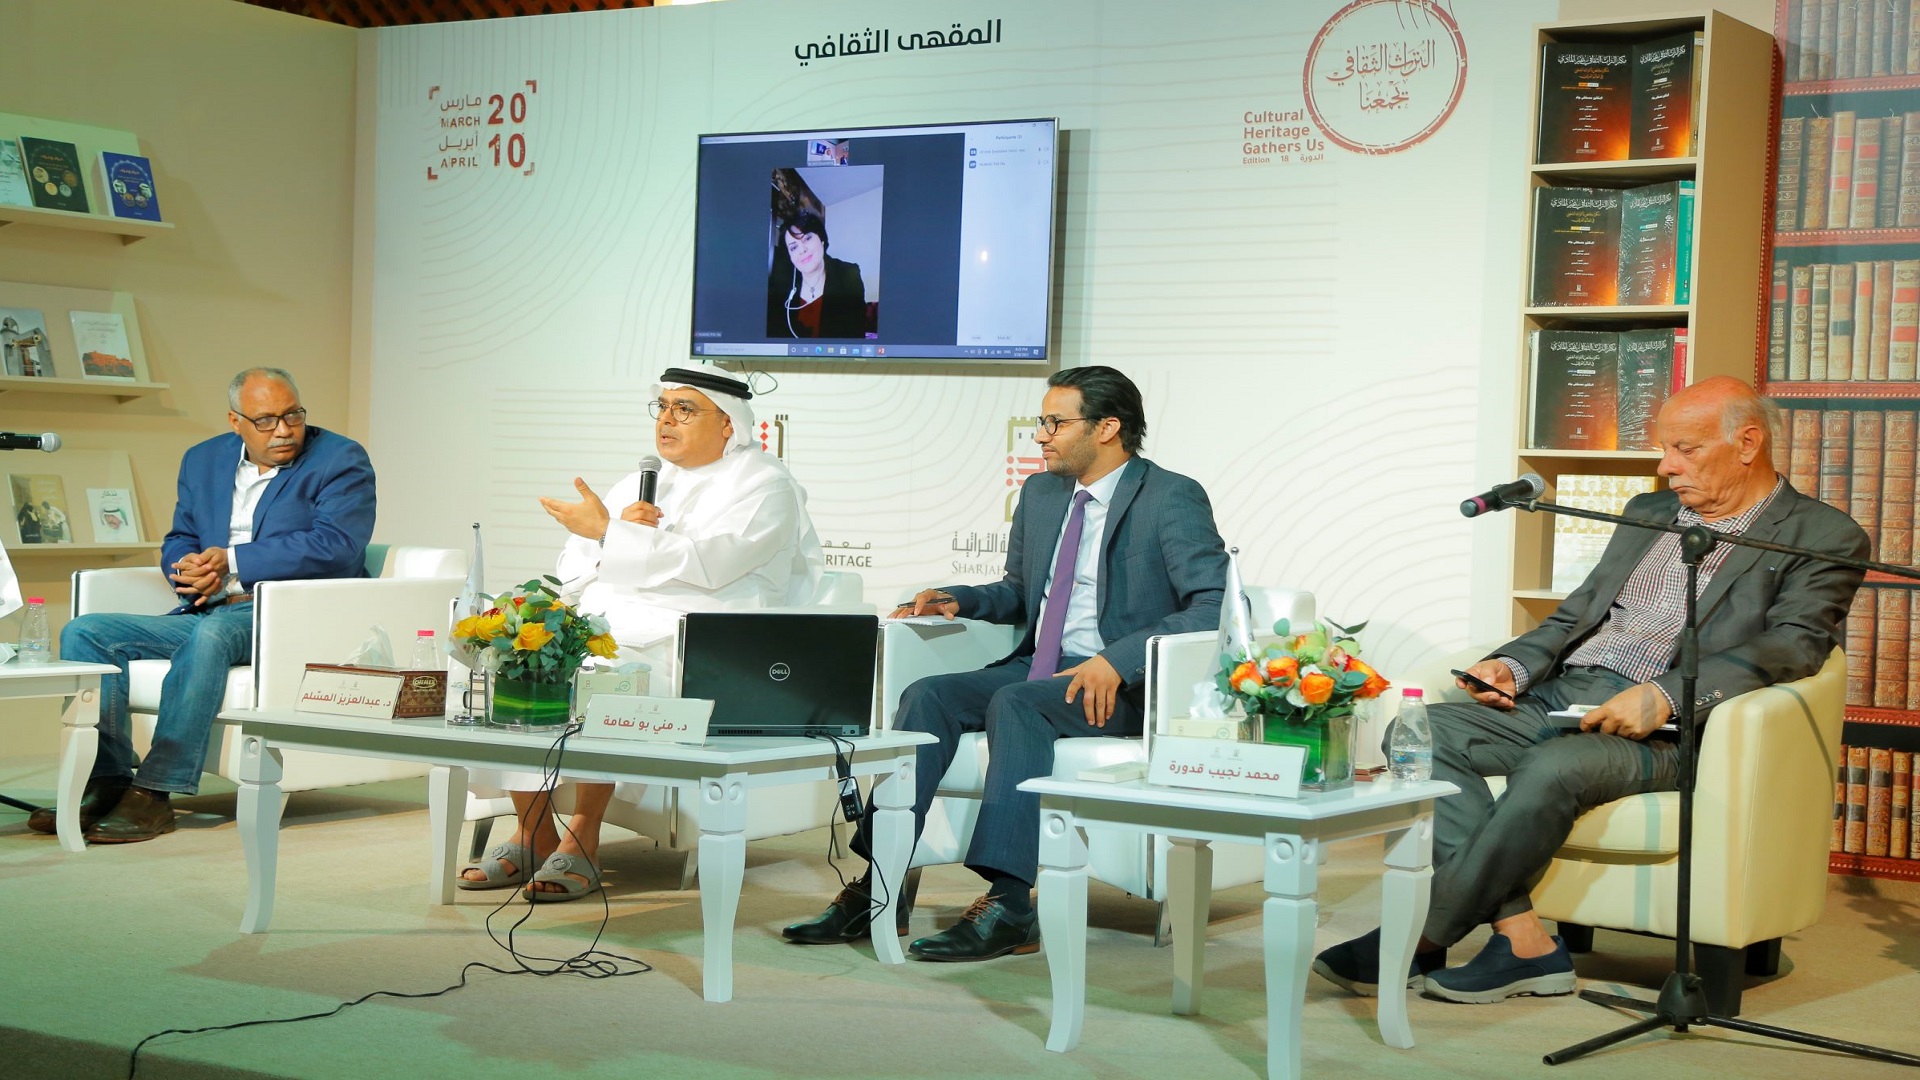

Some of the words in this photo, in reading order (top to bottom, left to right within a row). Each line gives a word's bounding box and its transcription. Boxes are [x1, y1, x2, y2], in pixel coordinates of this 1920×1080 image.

[897, 18, 1002, 51] المقهى
[794, 27, 889, 67] الثقافي
[440, 94, 482, 111] مارس
[487, 92, 526, 125] 20
[440, 116, 481, 128] MARCH
[1243, 108, 1304, 124] Cultural
[1243, 125, 1311, 140] Heritage
[438, 130, 479, 152] أبريل
[1242, 141, 1302, 155] Gathers
[1306, 138, 1325, 152] Us
[487, 133, 526, 168] 10
[440, 156, 479, 168] APRIL
[1242, 156, 1270, 165] Edition
[1280, 154, 1290, 163] 18
[1299, 153, 1324, 164] الدورة
[603, 715, 636, 728] نعامة
[638, 720, 650, 732] بو
[1169, 760, 1205, 775] قدورة
[1208, 767, 1241, 780] نجيب
[1245, 771, 1280, 781] محمد
